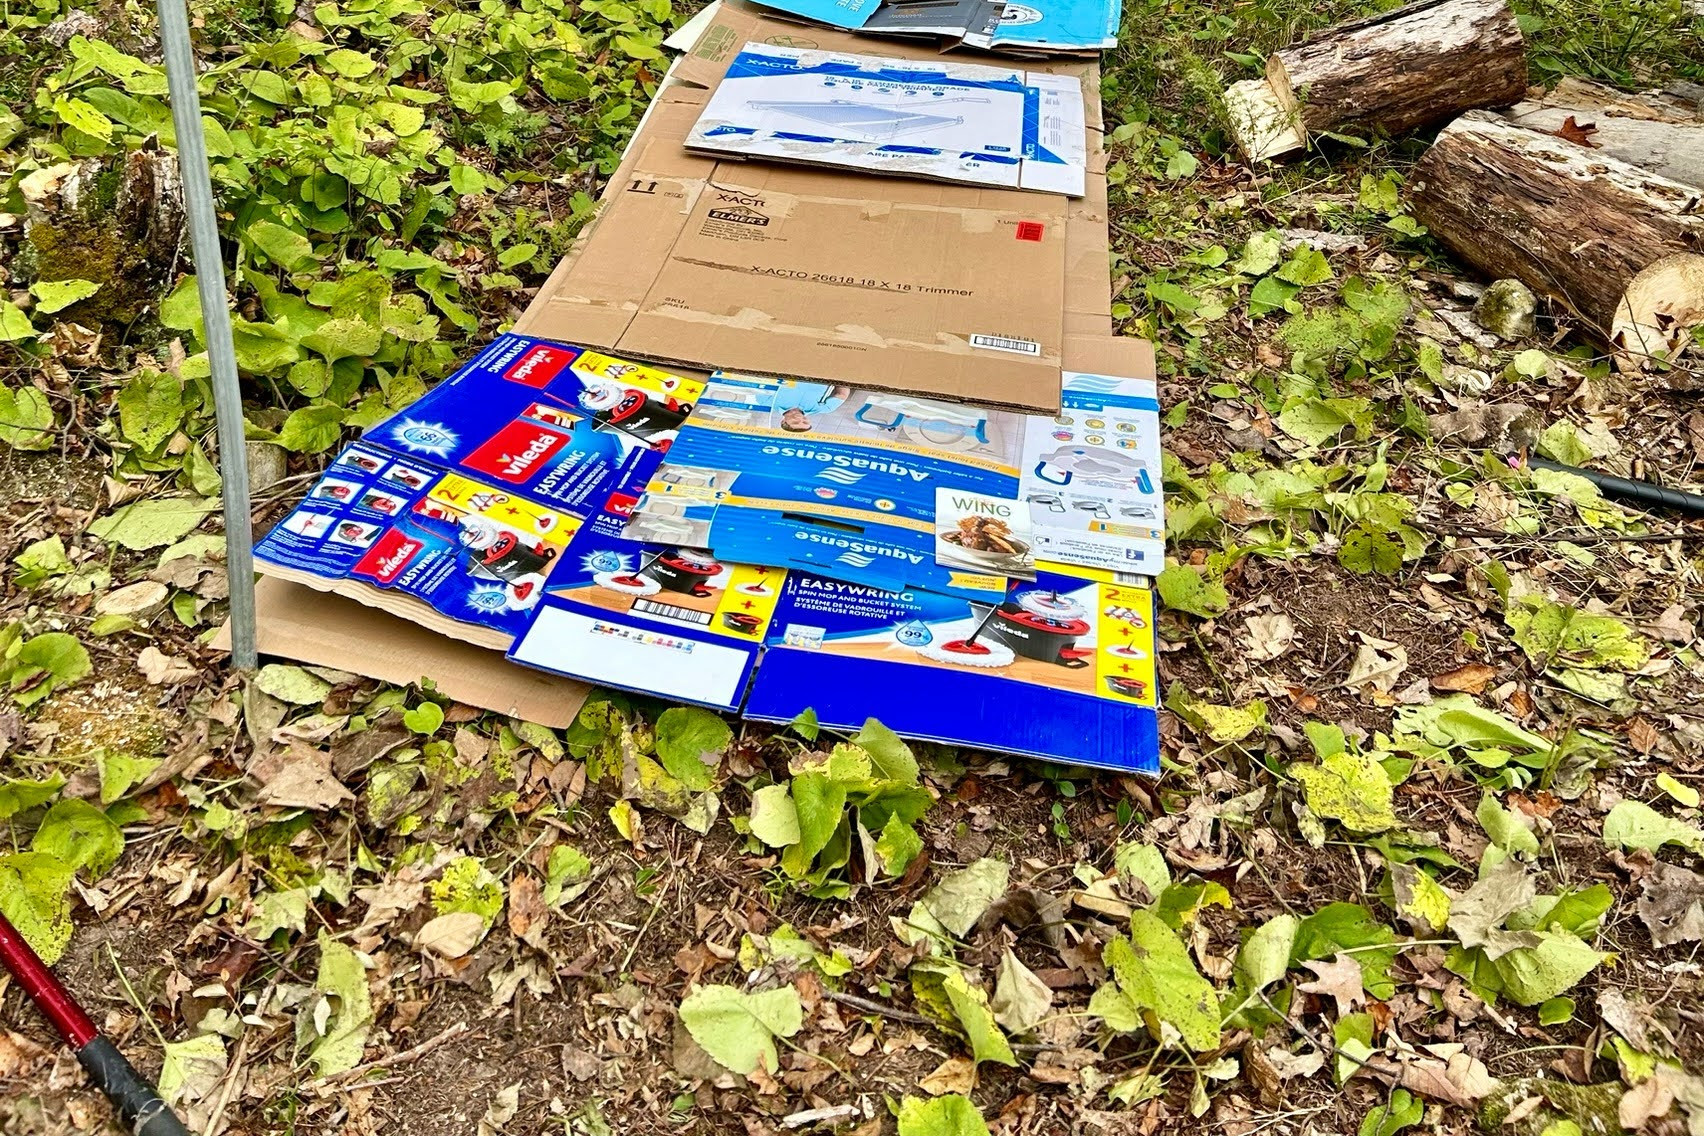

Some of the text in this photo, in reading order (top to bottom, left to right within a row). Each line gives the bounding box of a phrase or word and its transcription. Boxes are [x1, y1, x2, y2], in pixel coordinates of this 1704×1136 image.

[711, 210, 767, 226] ELMER'S
[750, 265, 975, 297] X-ACTO 26618 18 X 18 Trimmer
[502, 434, 559, 475] vileda
[763, 444, 930, 482] AquaSense
[533, 450, 586, 496] EASYWRING
[952, 496, 1011, 517] WING
[794, 530, 924, 565] AquaSense
[378, 542, 416, 578] vileda
[798, 589, 922, 611] SPIN MOP AND BUCKET SYSTEM
[800, 578, 914, 602] EASYWRING
[1105, 588, 1121, 601] 2
[794, 602, 887, 620] D'ESSOREUSE ROTATIVE
[844, 604, 894, 616] VADROUILLE
[992, 621, 1029, 640] vileda
